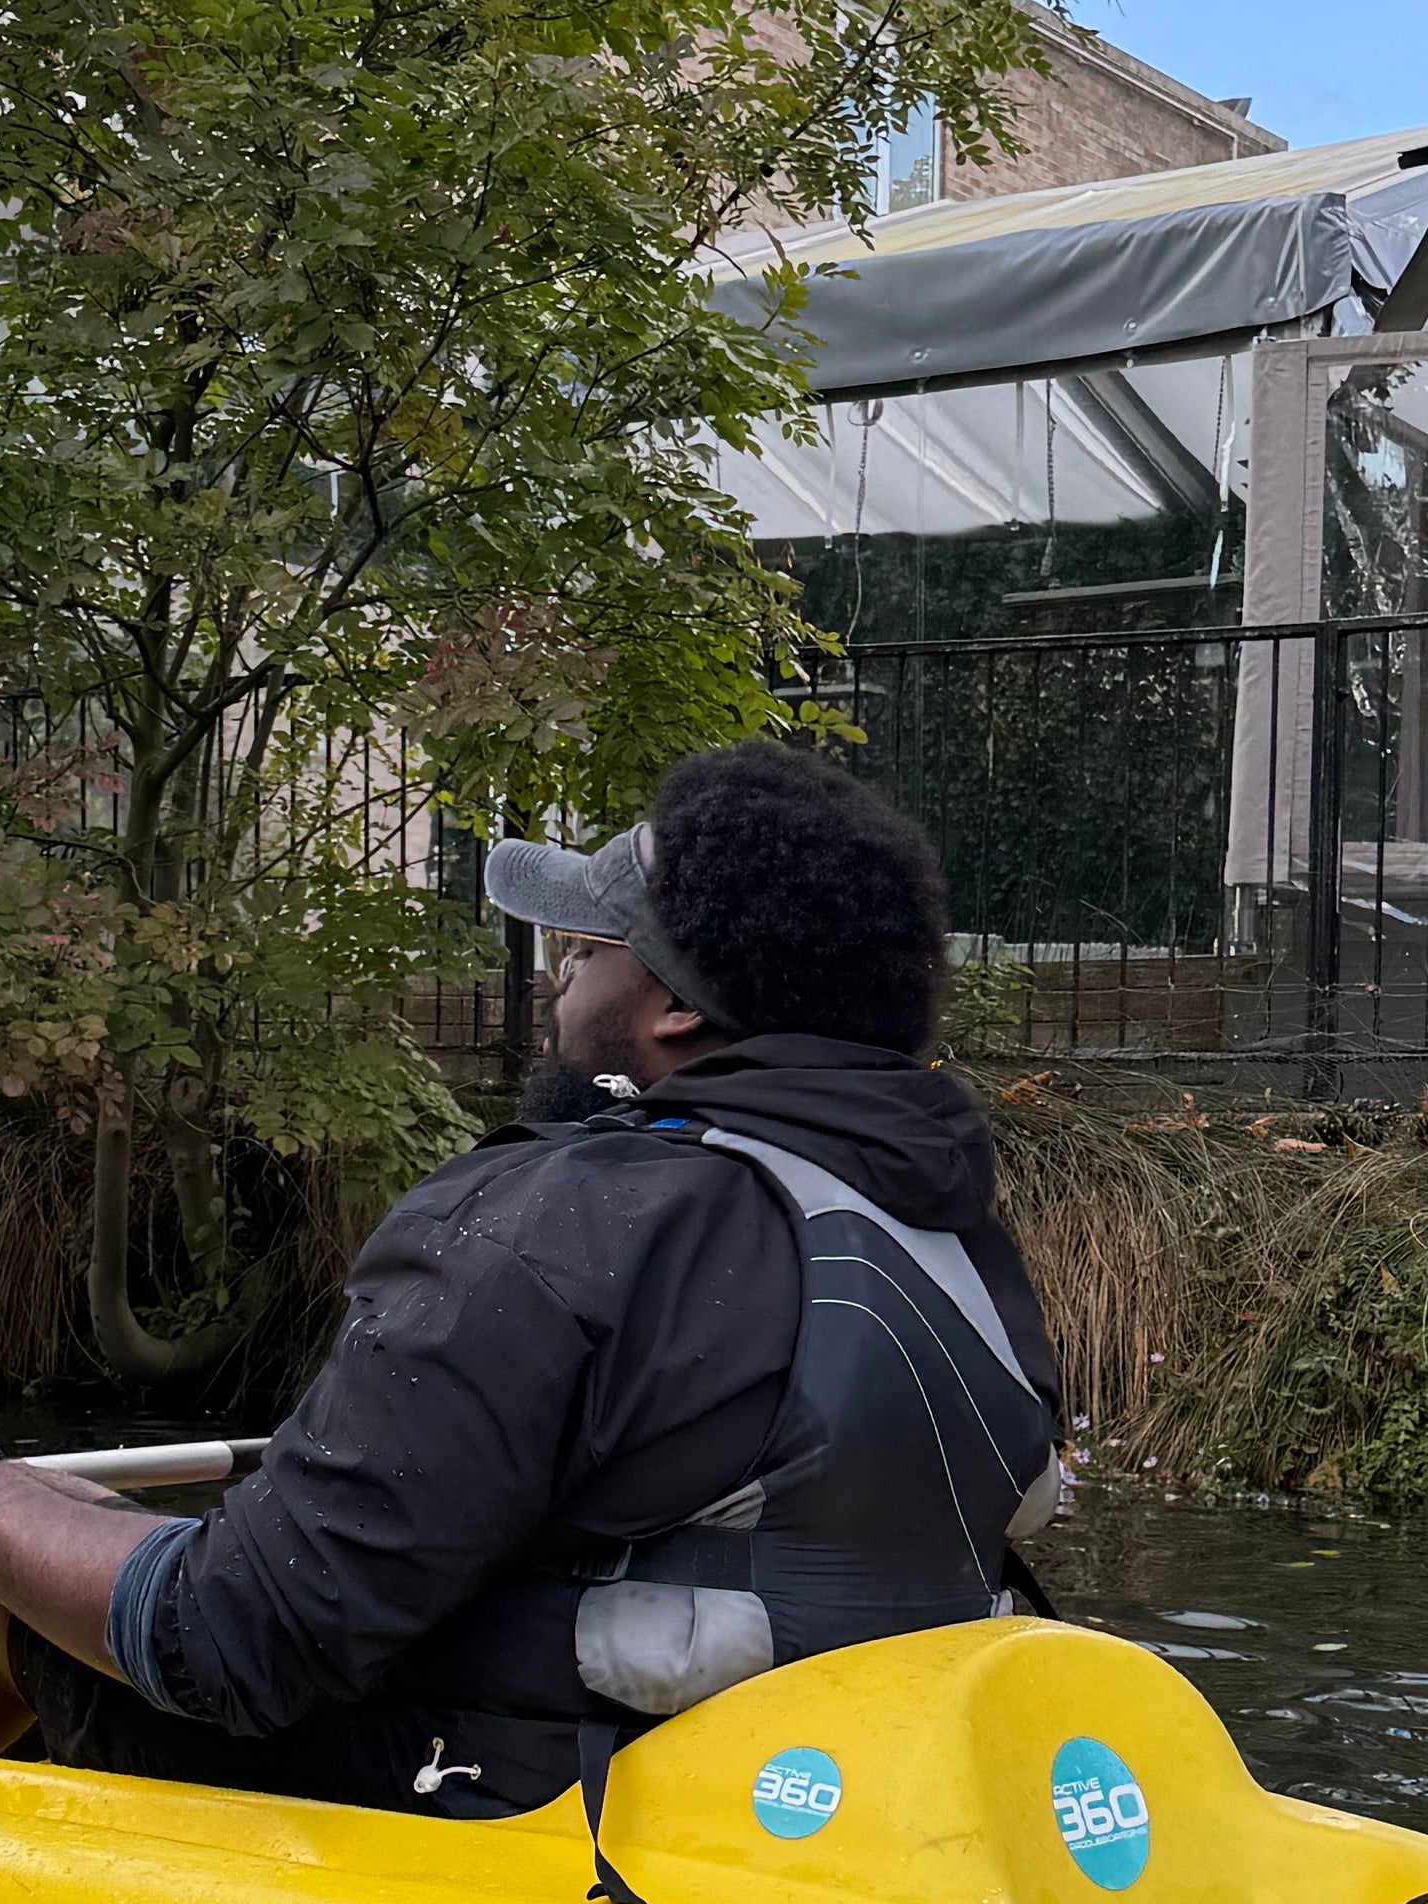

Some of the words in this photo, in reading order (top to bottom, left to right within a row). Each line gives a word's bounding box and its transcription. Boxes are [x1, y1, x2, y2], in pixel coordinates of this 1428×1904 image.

[753, 1770, 841, 1813] 360
[1053, 1777, 1100, 1796] ACTIVE
[1053, 1783, 1149, 1842] 360
